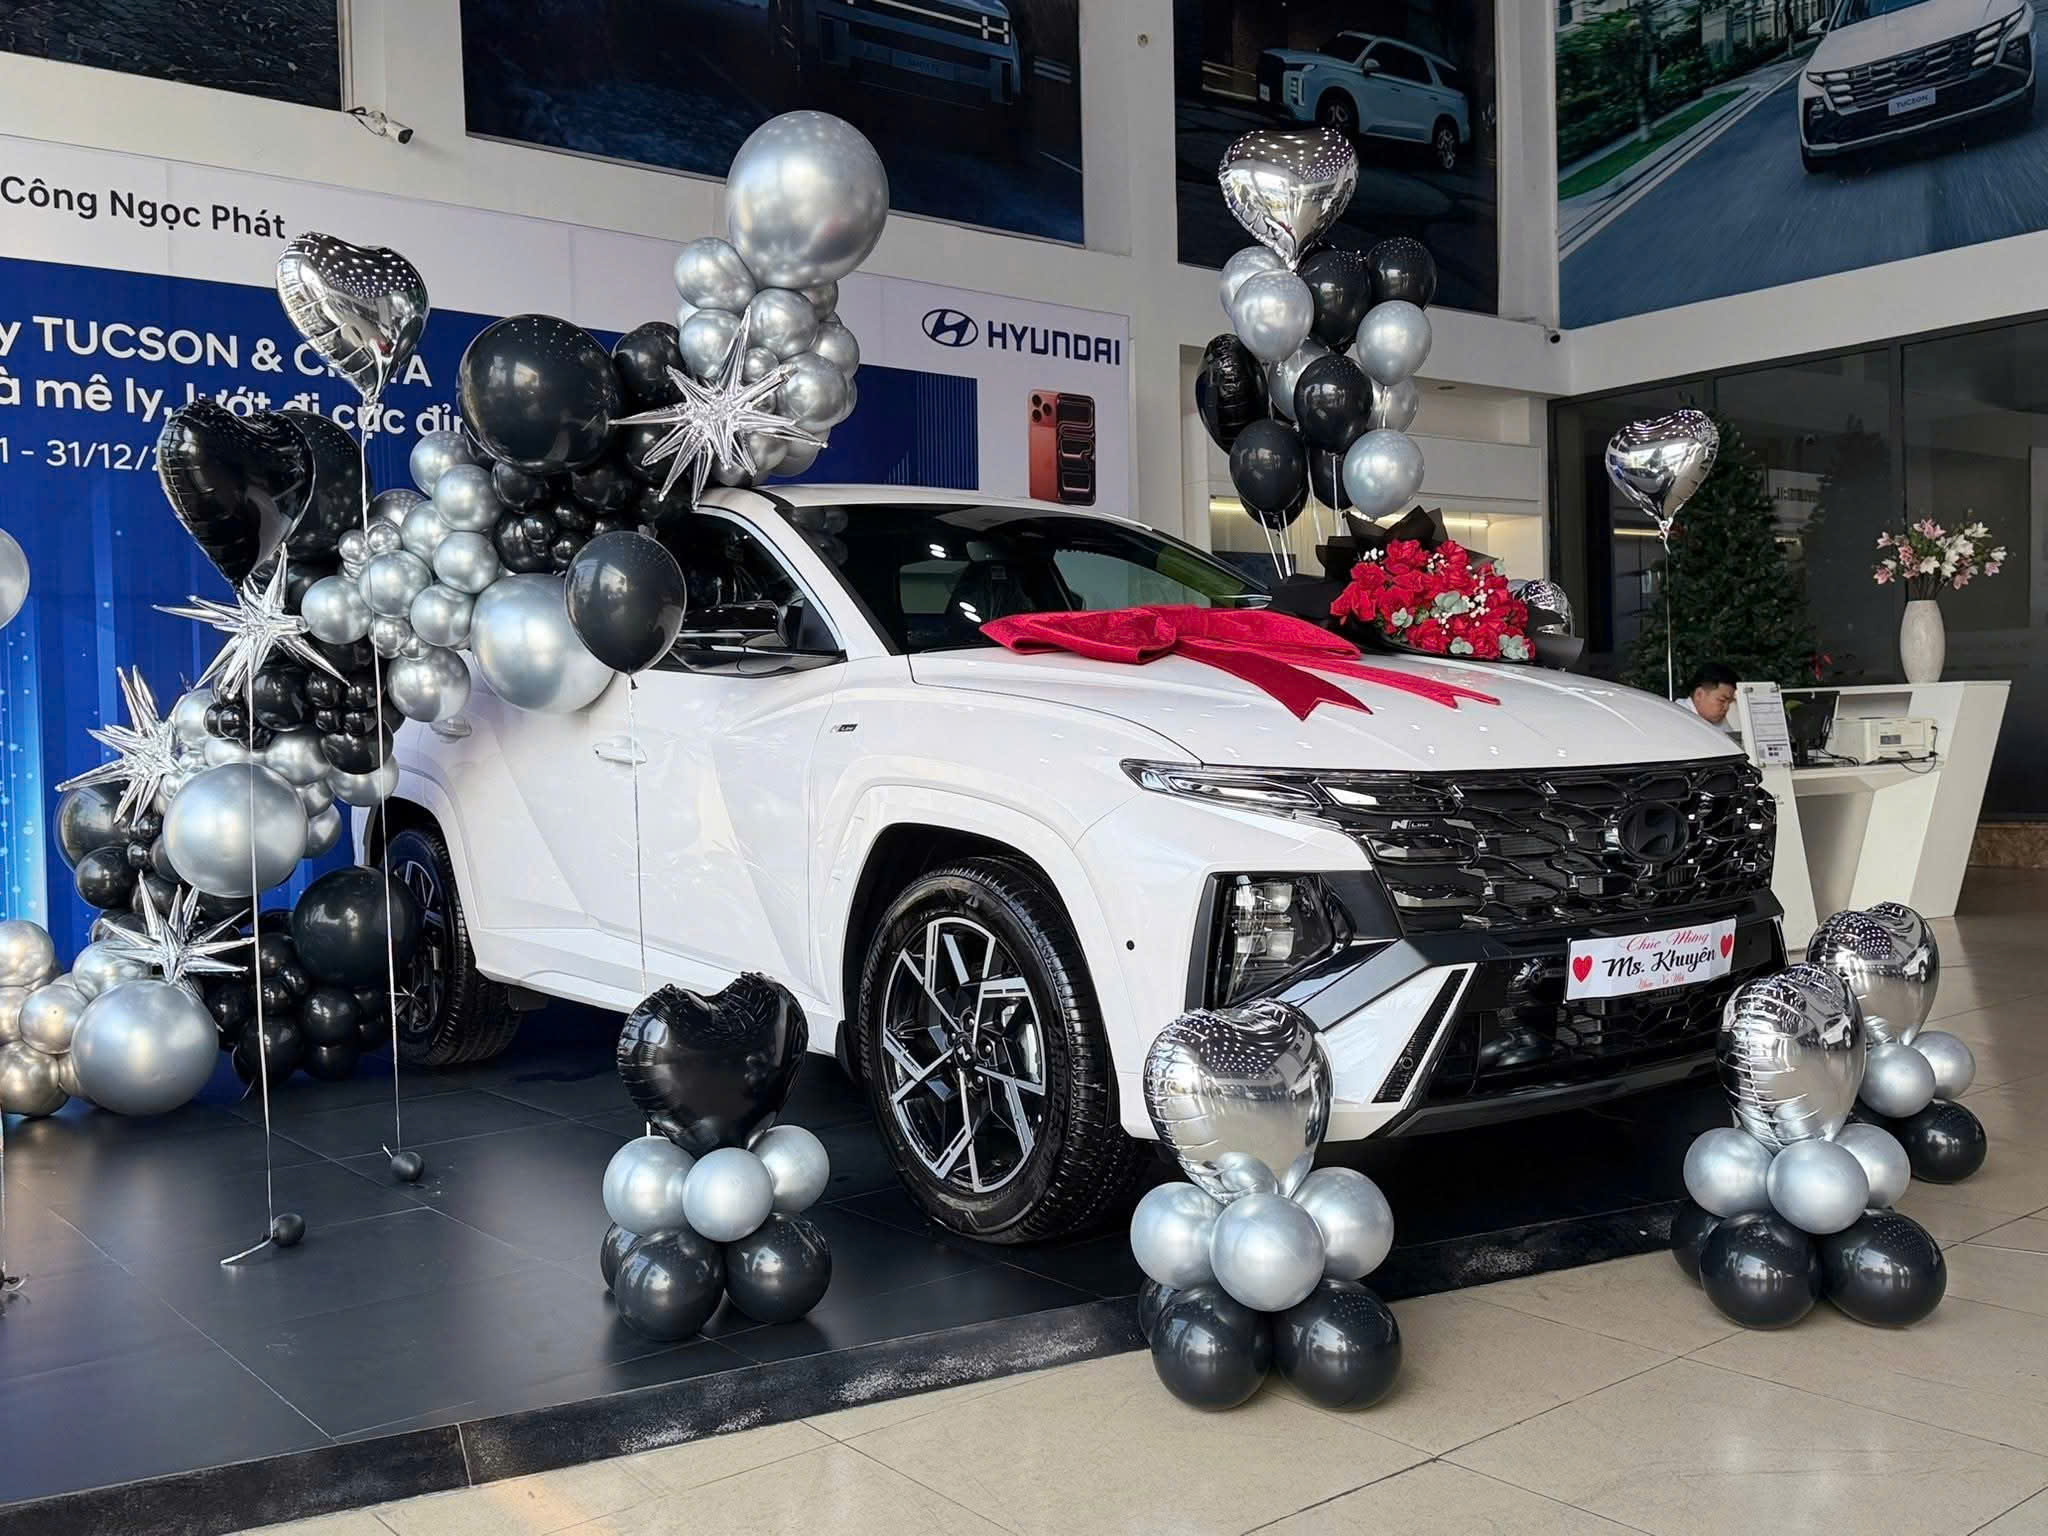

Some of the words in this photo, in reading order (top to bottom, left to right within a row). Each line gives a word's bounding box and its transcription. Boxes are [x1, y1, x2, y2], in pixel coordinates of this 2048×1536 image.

[1, 176, 97, 219] Công
[110, 190, 200, 230] Ngọc
[212, 204, 286, 239] Phát
[33, 316, 238, 368] TUCSON
[251, 338, 283, 373] &
[988, 320, 1120, 365] HYUNDAI
[36, 373, 113, 412] mê
[125, 377, 173, 423] ly,
[1602, 956, 1645, 976] Ms.
